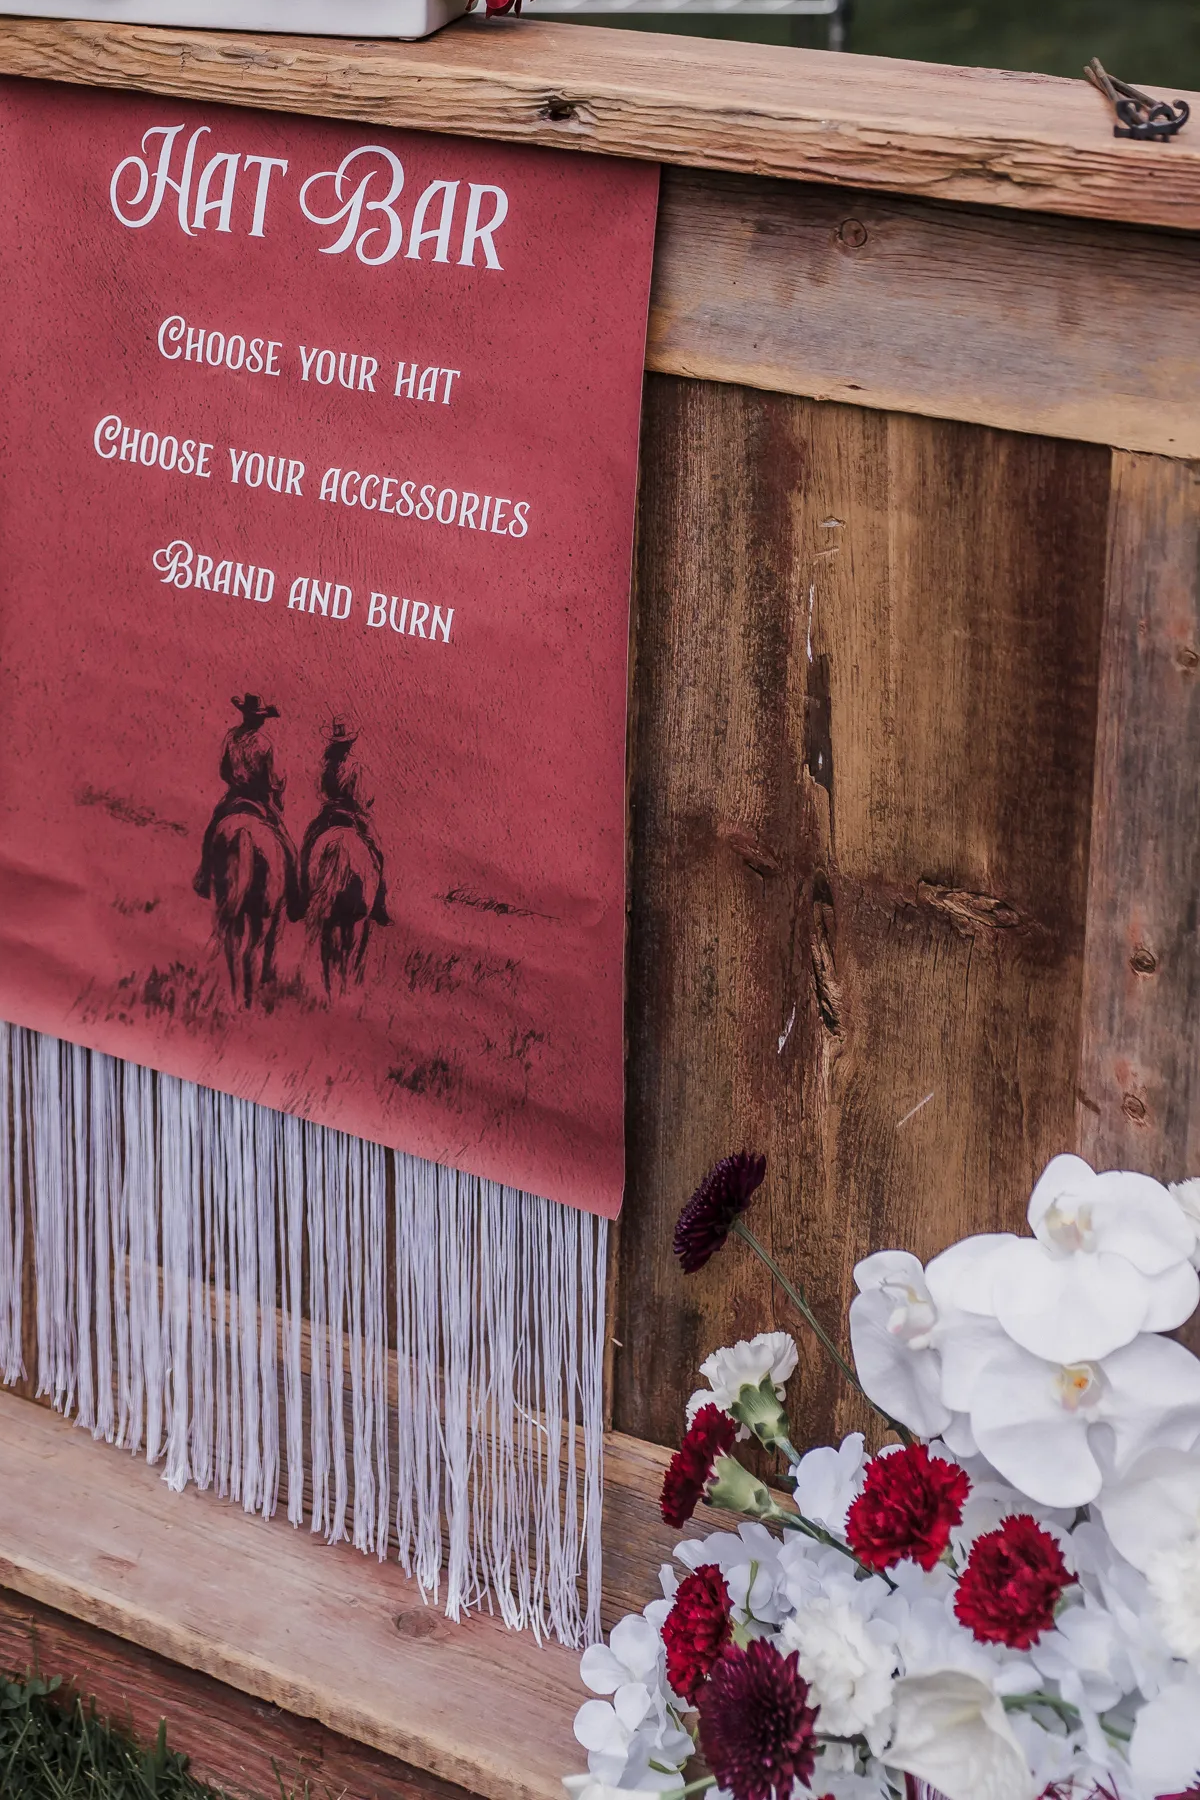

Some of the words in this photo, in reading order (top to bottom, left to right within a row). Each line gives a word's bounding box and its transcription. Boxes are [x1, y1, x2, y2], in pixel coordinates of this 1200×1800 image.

[110, 124, 288, 237] HAT
[300, 146, 508, 270] BAR
[158, 316, 282, 376] CHOOSE
[299, 346, 377, 392] YOUR
[394, 362, 460, 404] HAT
[94, 415, 213, 477] CHOOSE
[229, 448, 305, 496] YOUR
[319, 468, 530, 537] ACCESSORIES
[153, 540, 274, 602] BRAND
[287, 577, 352, 619] AND
[367, 592, 454, 643] BURN
